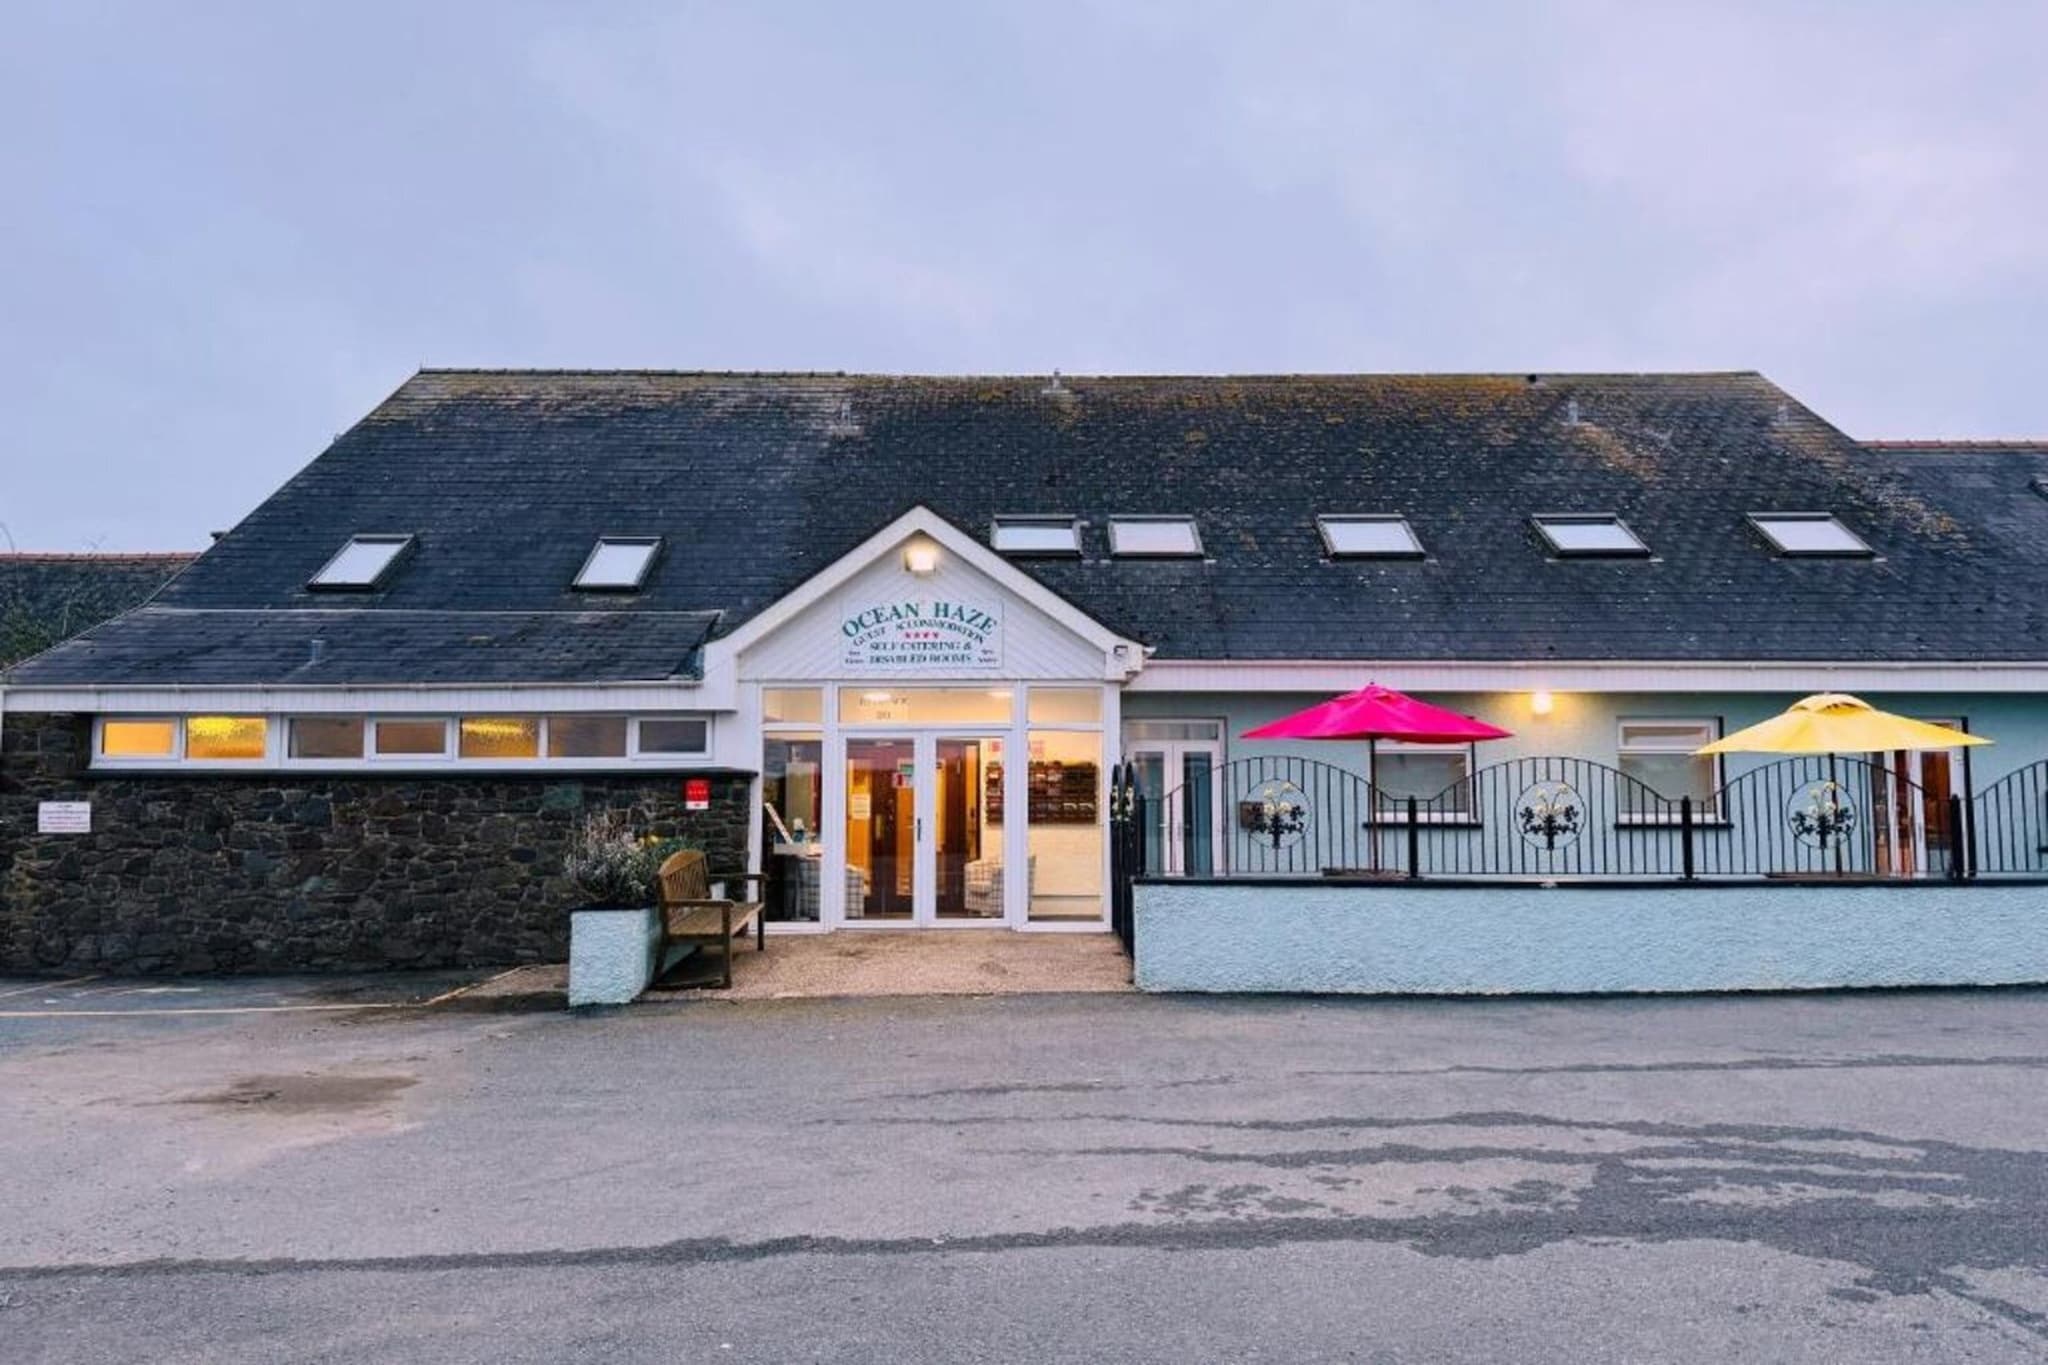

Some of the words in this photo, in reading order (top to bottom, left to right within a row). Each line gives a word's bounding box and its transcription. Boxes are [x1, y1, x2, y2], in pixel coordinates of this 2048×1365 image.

[842, 602, 919, 637] OCEAN
[934, 602, 998, 635] HAZE
[853, 627, 887, 647] GUEST
[870, 641, 896, 651] SELF
[901, 641, 961, 651] CATERING
[963, 641, 972, 650] &
[870, 654, 927, 664] DISABLED
[929, 653, 971, 664] ROOMS
